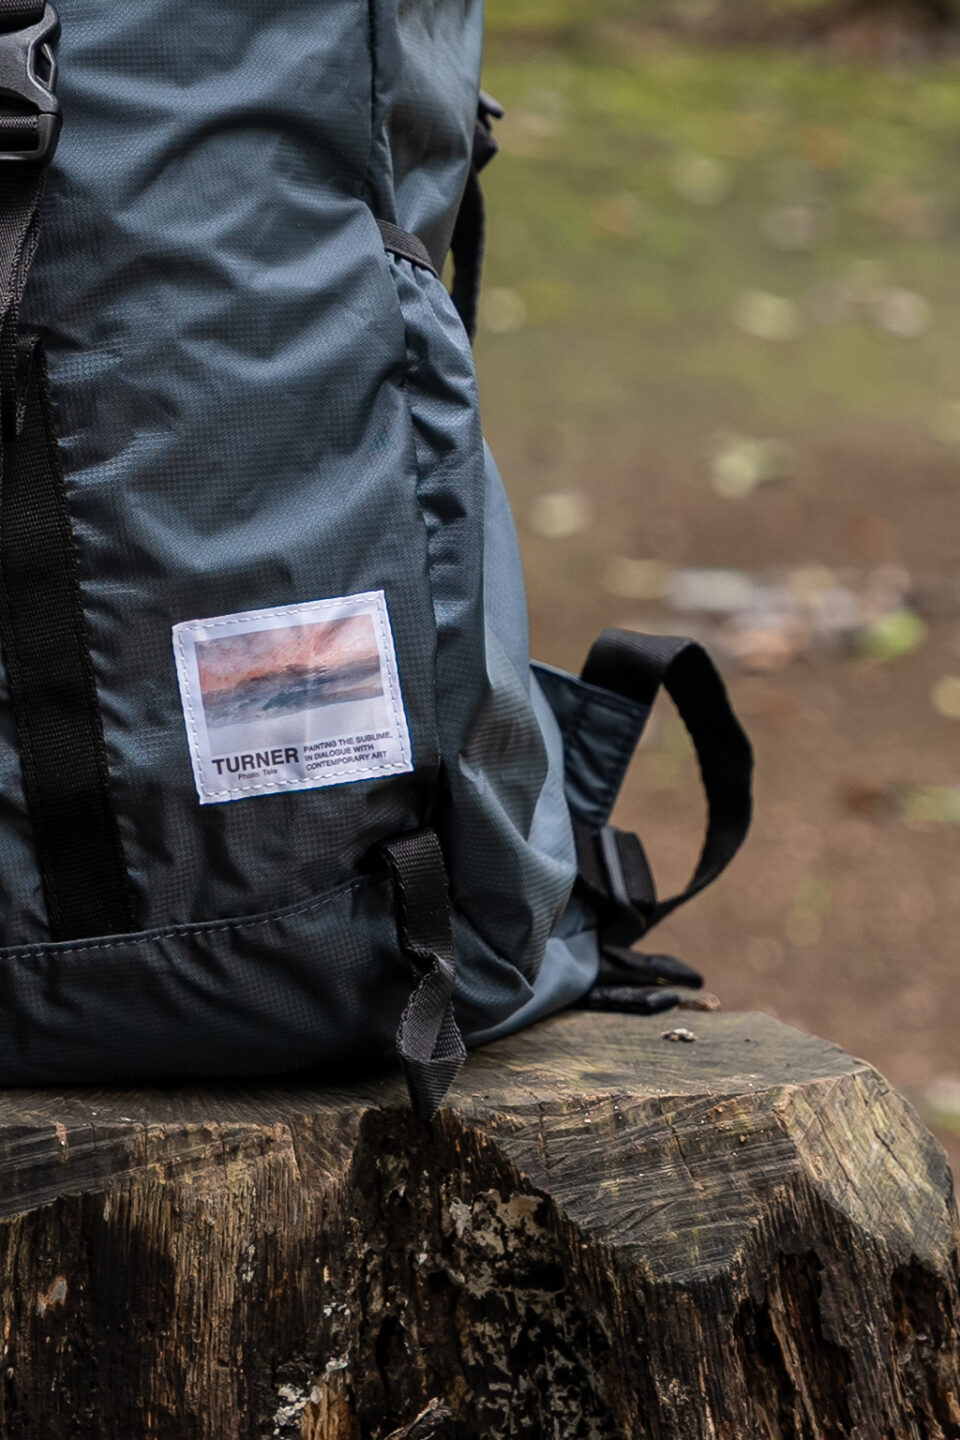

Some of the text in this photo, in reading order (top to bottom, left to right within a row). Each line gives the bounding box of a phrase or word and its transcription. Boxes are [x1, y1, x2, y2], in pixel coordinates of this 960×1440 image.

[303, 740, 337, 753] PAINTING
[338, 737, 355, 746] THE
[304, 743, 375, 762] IN DIALOGUE WITH
[211, 747, 300, 775] TURNER
[305, 750, 388, 771] CONTEMPORARY ART
